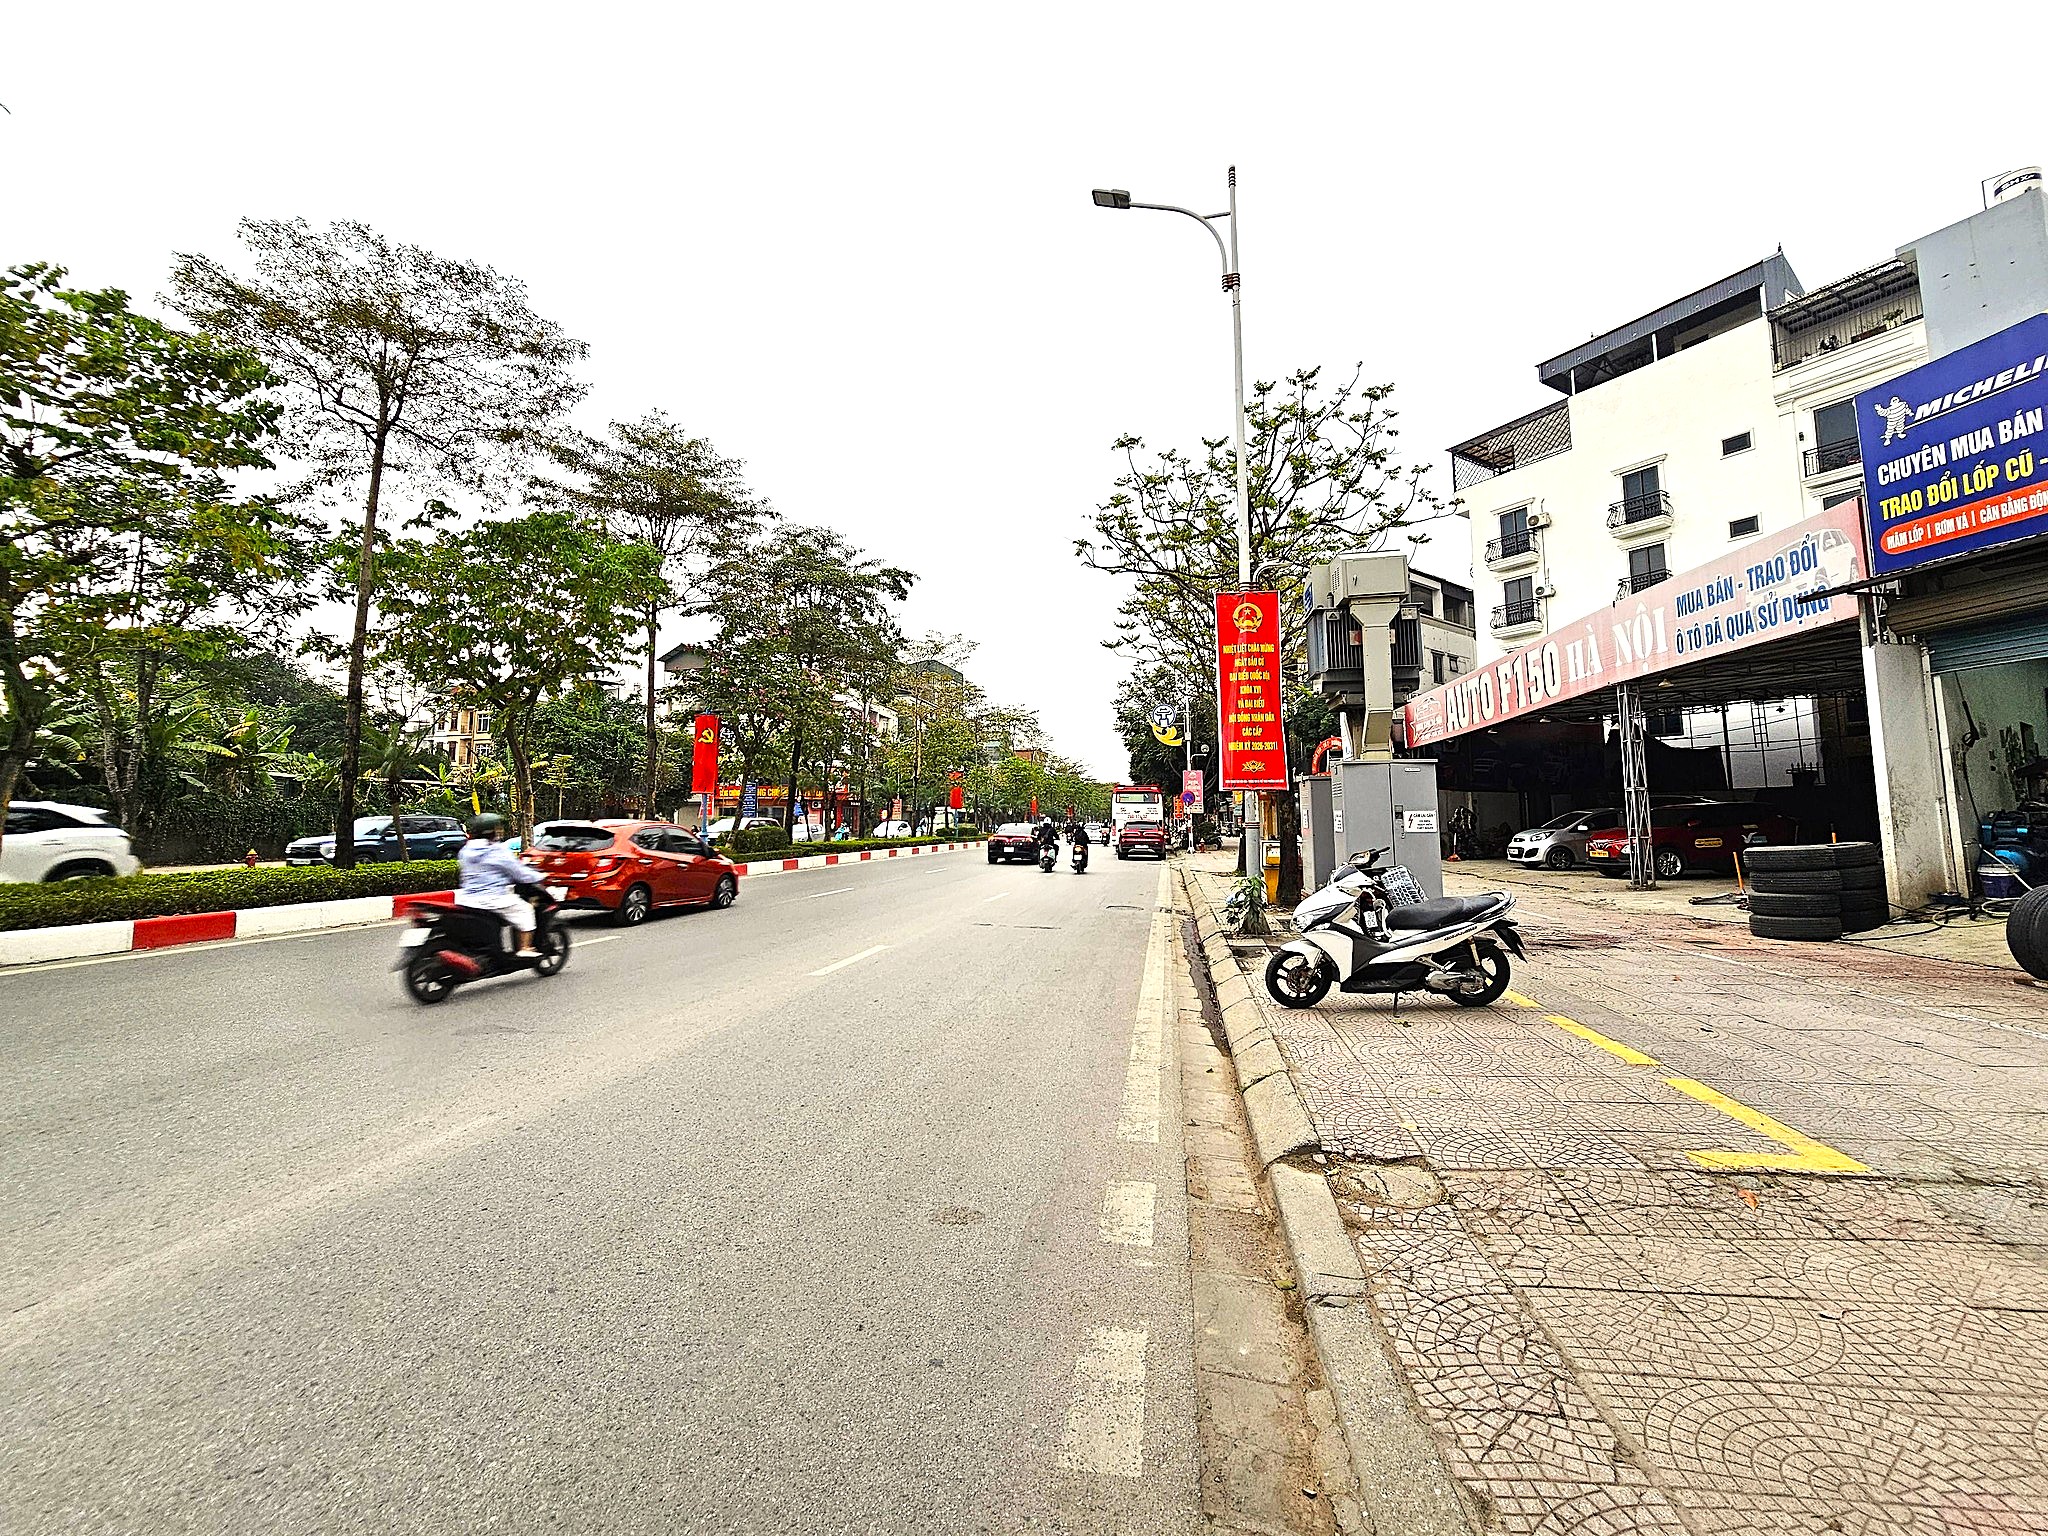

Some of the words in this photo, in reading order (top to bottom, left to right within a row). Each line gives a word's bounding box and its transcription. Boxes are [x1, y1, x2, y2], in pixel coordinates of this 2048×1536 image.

[1914, 354, 2048, 421] MICHELI
[1877, 444, 1947, 486] CHUYÊN
[1949, 426, 1995, 461] MUA
[1997, 407, 2044, 445] BÁN
[1879, 489, 1923, 521] TRAO
[1926, 470, 1959, 507] ĐỔI
[1962, 459, 1999, 496] LỐP
[2005, 447, 2034, 482] CŨ
[1908, 523, 1924, 544] LỐP
[1934, 518, 1956, 537] BƠM
[1956, 510, 1969, 531] VÁ
[1979, 504, 2000, 524] CÂN
[2000, 496, 2029, 518] BẰNG
[1676, 588, 1704, 618] MUA
[1706, 575, 1734, 608] BÁN
[1746, 556, 1785, 592] TRAO
[1789, 533, 1818, 577] ĐỔI
[1676, 628, 1684, 654] Ô
[1686, 623, 1702, 651] TÔ
[1704, 616, 1723, 646] ĐÃ
[1726, 610, 1755, 642] QUA
[1758, 591, 1779, 630] SỬ
[1445, 671, 1495, 733] AUTO
[1496, 640, 1562, 715] F150
[1565, 623, 1604, 684] HÀ
[1612, 601, 1669, 673] NỘI
